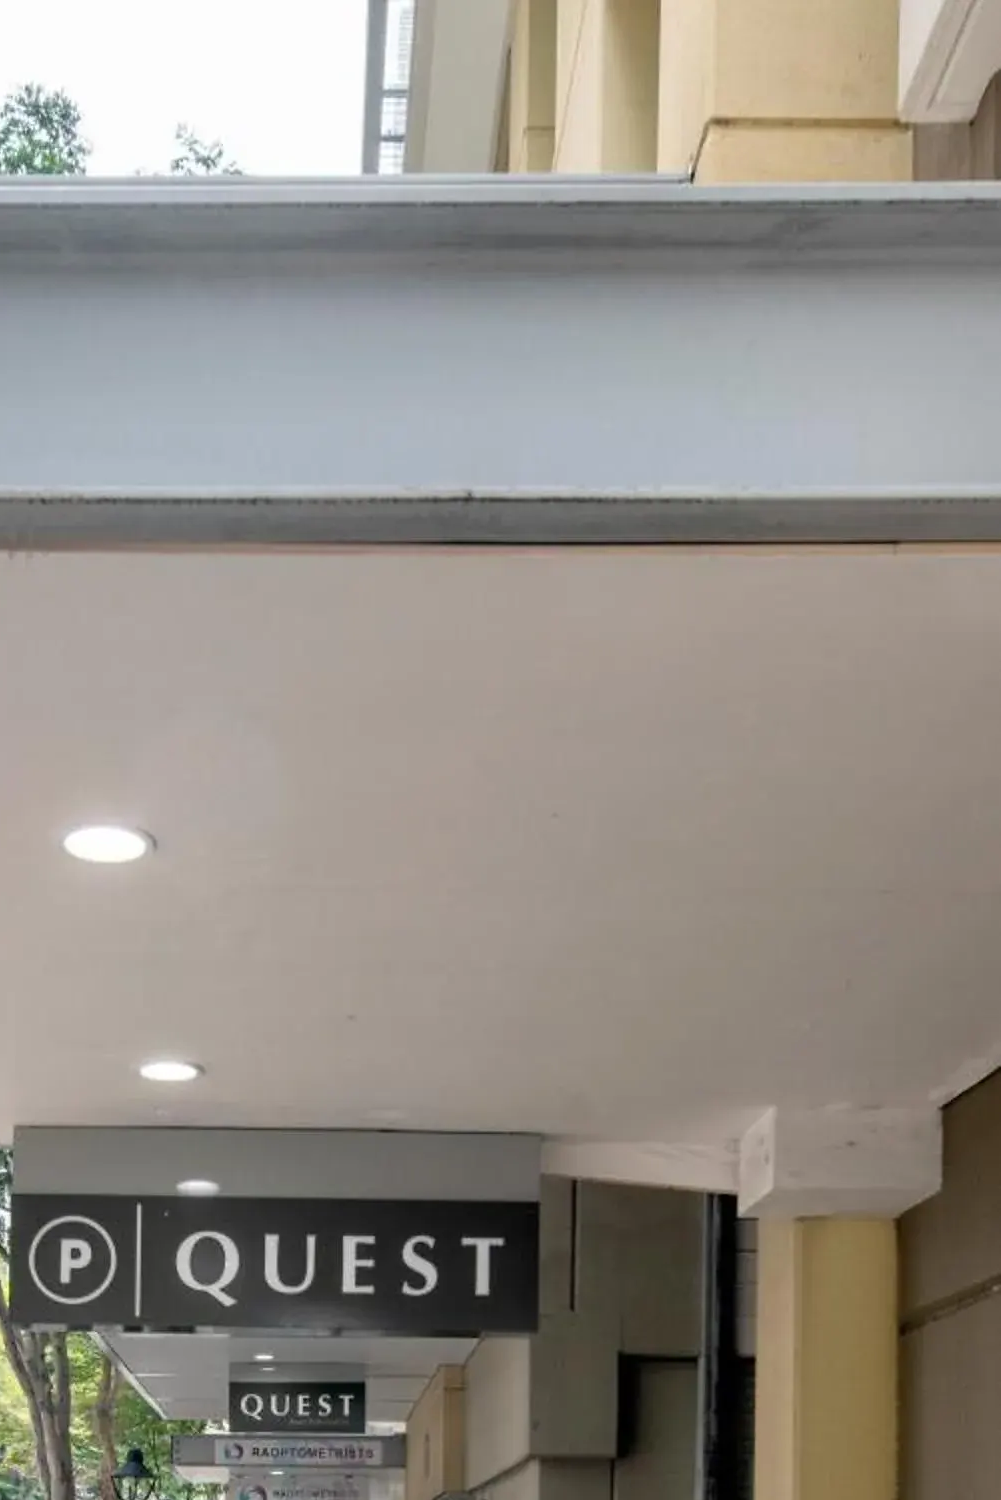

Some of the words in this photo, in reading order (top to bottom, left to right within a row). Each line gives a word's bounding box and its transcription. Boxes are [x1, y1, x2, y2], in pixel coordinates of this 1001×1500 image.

[59, 1239, 92, 1284] P
[175, 1231, 505, 1307] QUEST
[240, 1393, 355, 1420] QUEST
